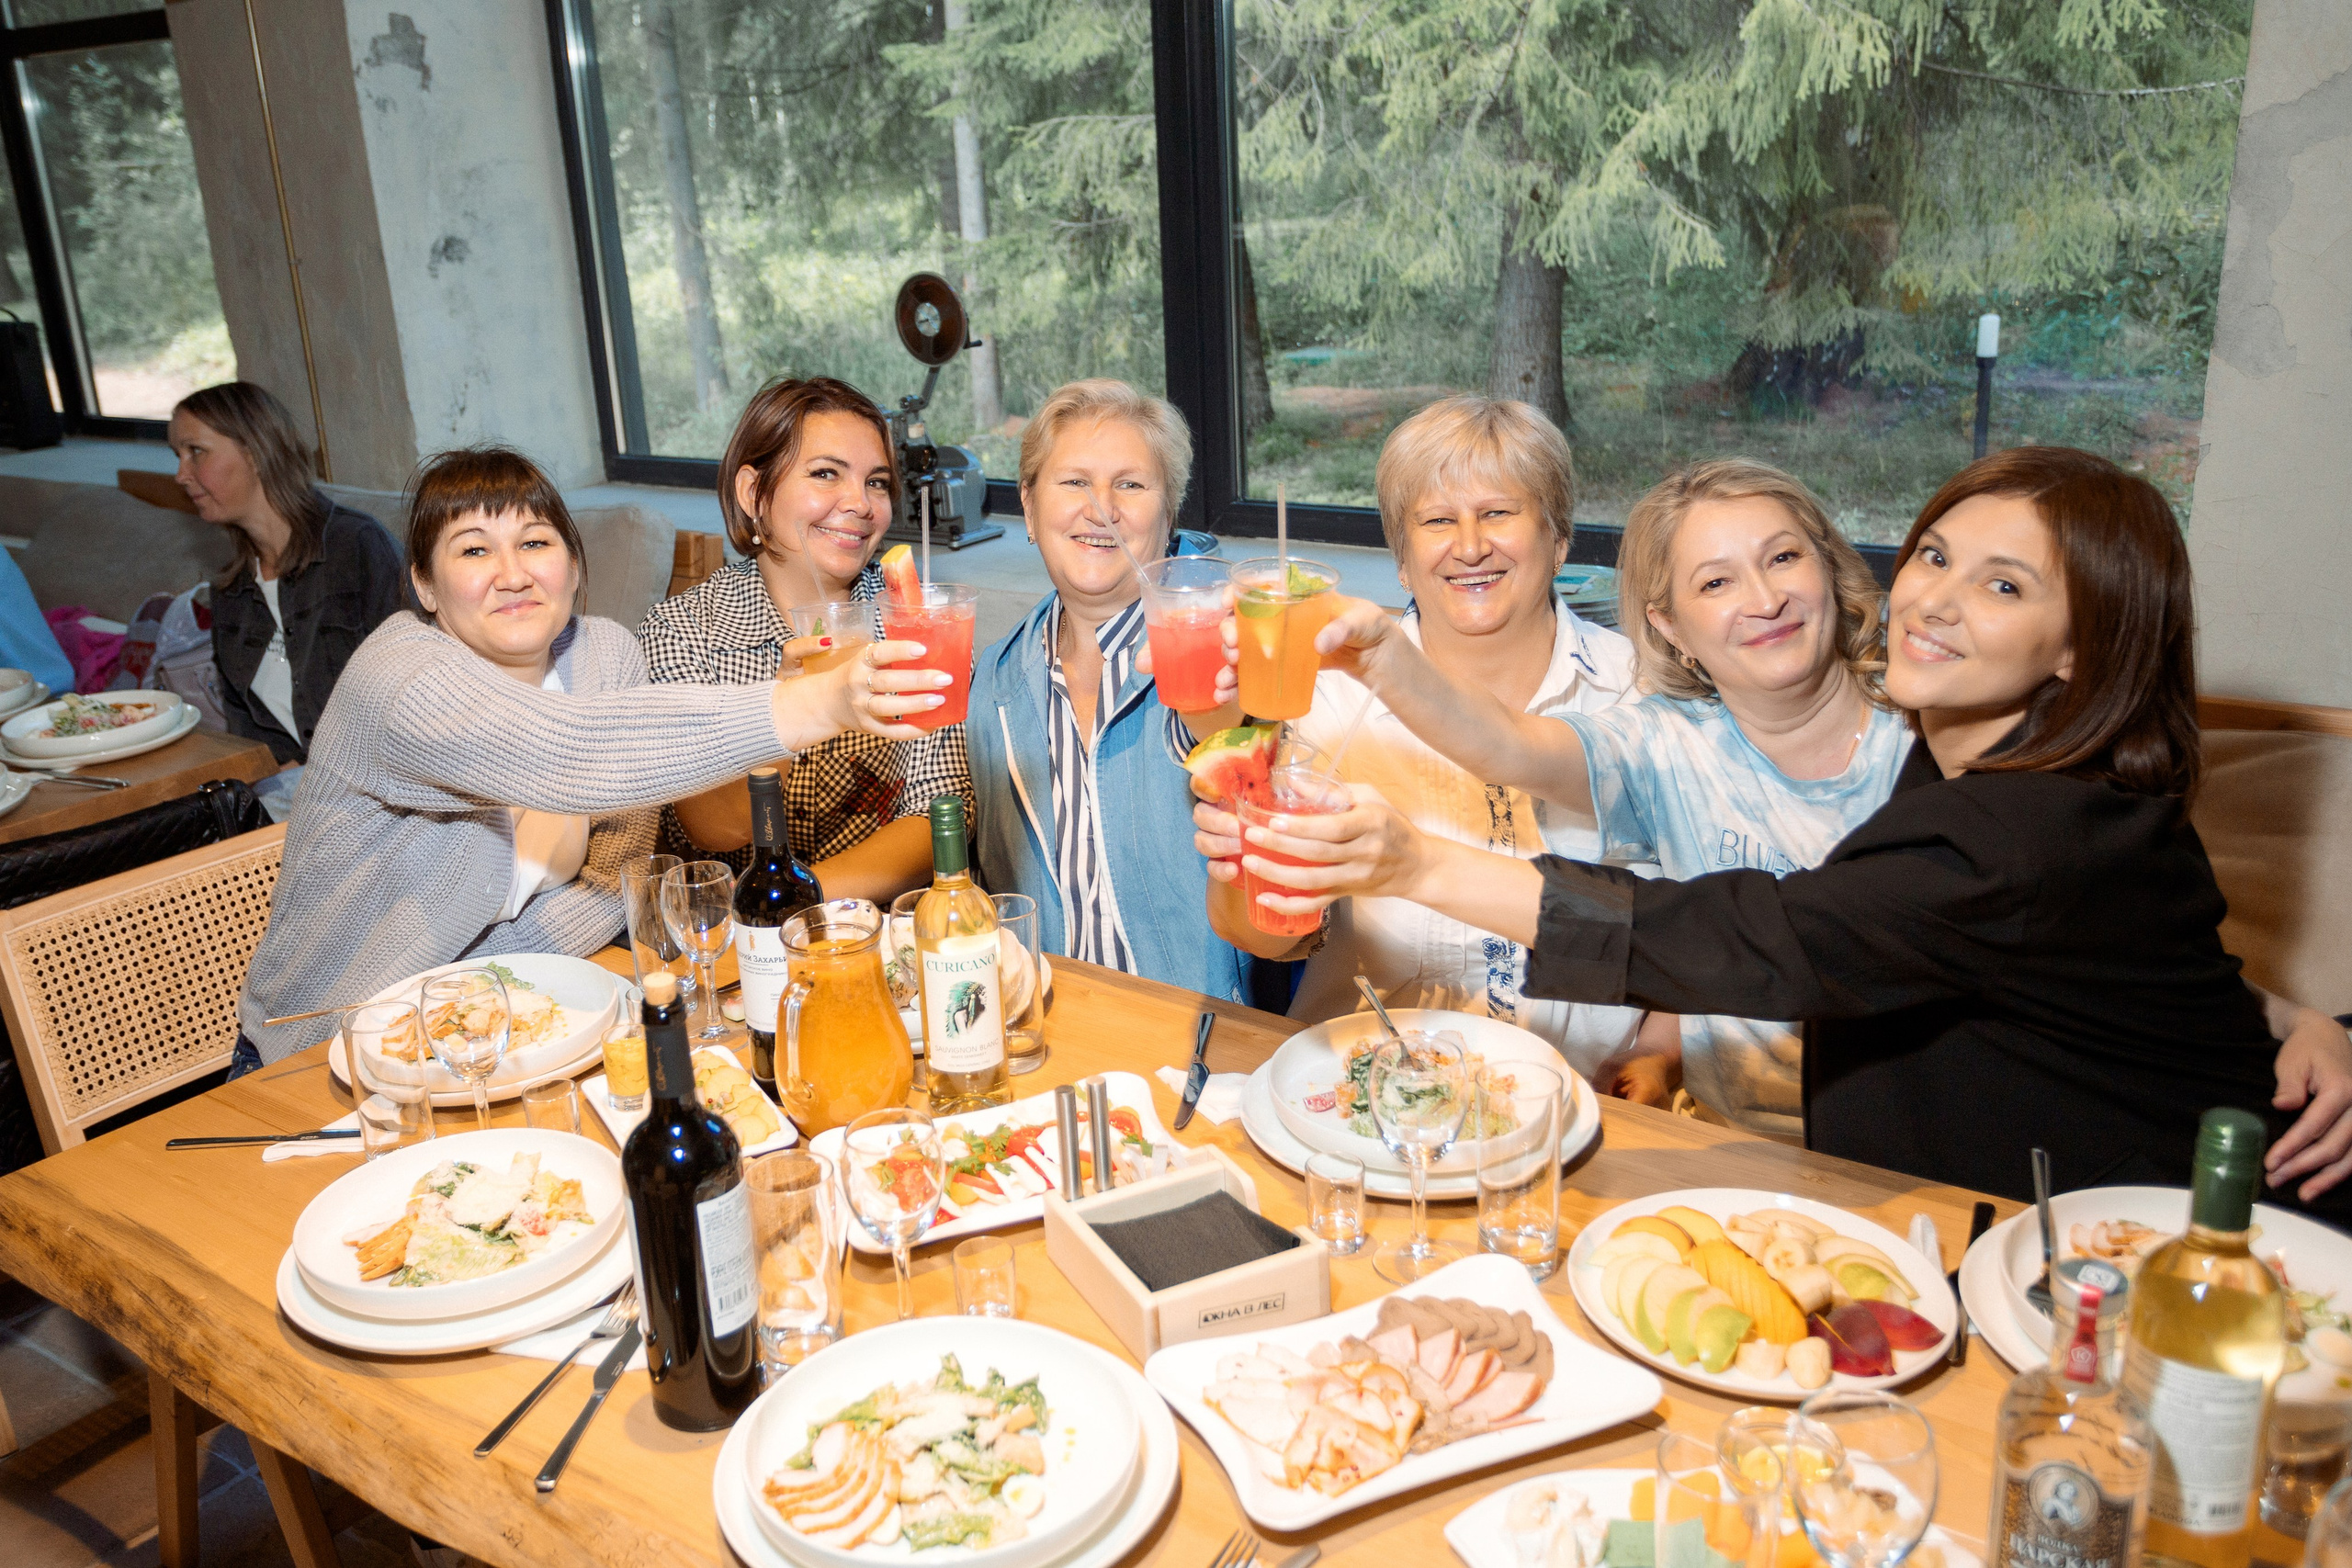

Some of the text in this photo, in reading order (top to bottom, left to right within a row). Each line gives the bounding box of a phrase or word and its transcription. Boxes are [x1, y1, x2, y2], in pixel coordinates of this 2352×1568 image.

[926, 953, 995, 973] CURICANO
[934, 1037, 1000, 1055] SAUVIGNON BLANC
[1203, 1307, 1240, 1323] ОКНА
[1257, 1297, 1282, 1312] ЛЕС
